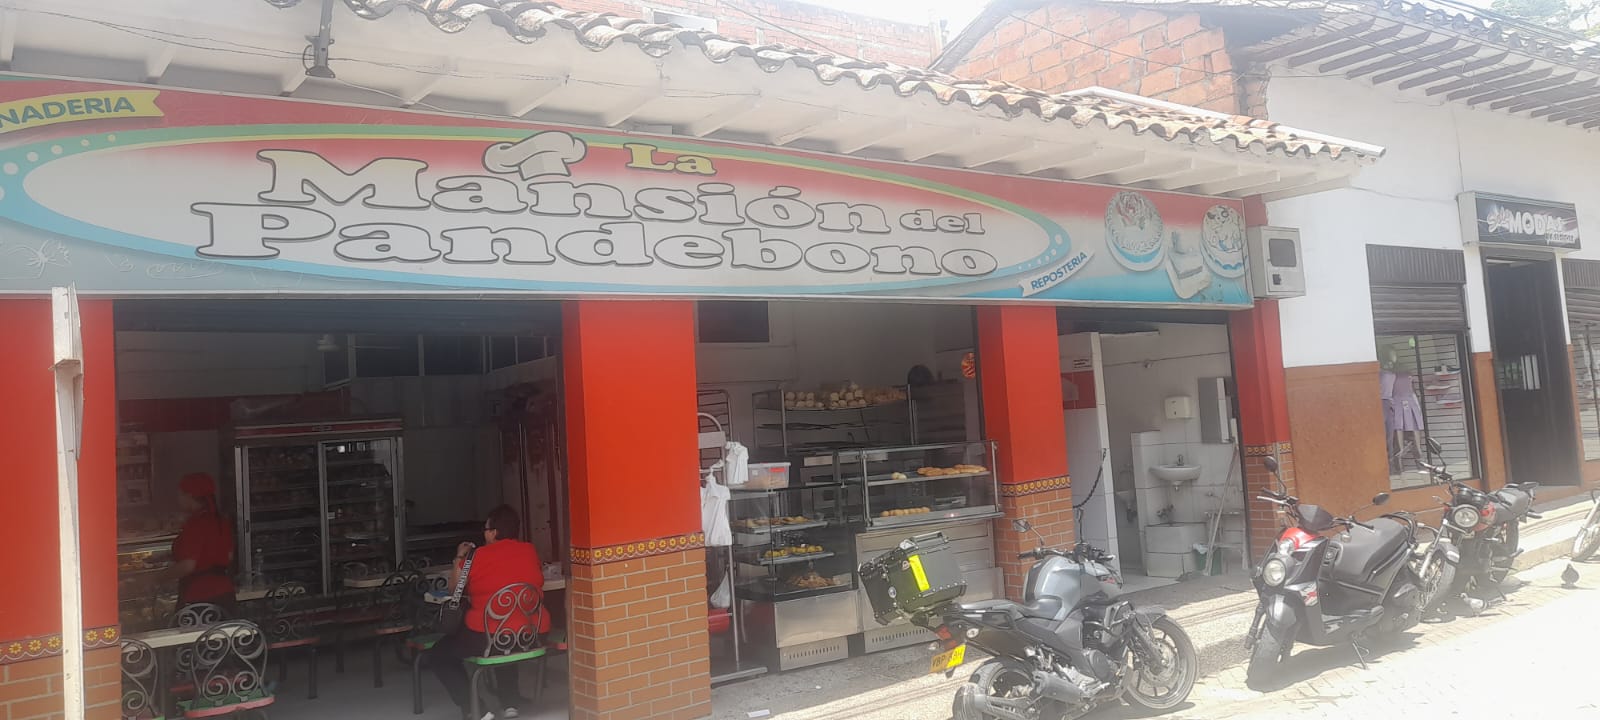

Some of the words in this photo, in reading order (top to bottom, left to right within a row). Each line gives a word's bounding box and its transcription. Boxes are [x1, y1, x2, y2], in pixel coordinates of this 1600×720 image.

[623, 142, 718, 176] La
[257, 149, 891, 234] Mansión
[899, 209, 985, 235] del
[191, 202, 999, 277] Pandebono
[1030, 251, 1088, 290] REPOSTERIA
